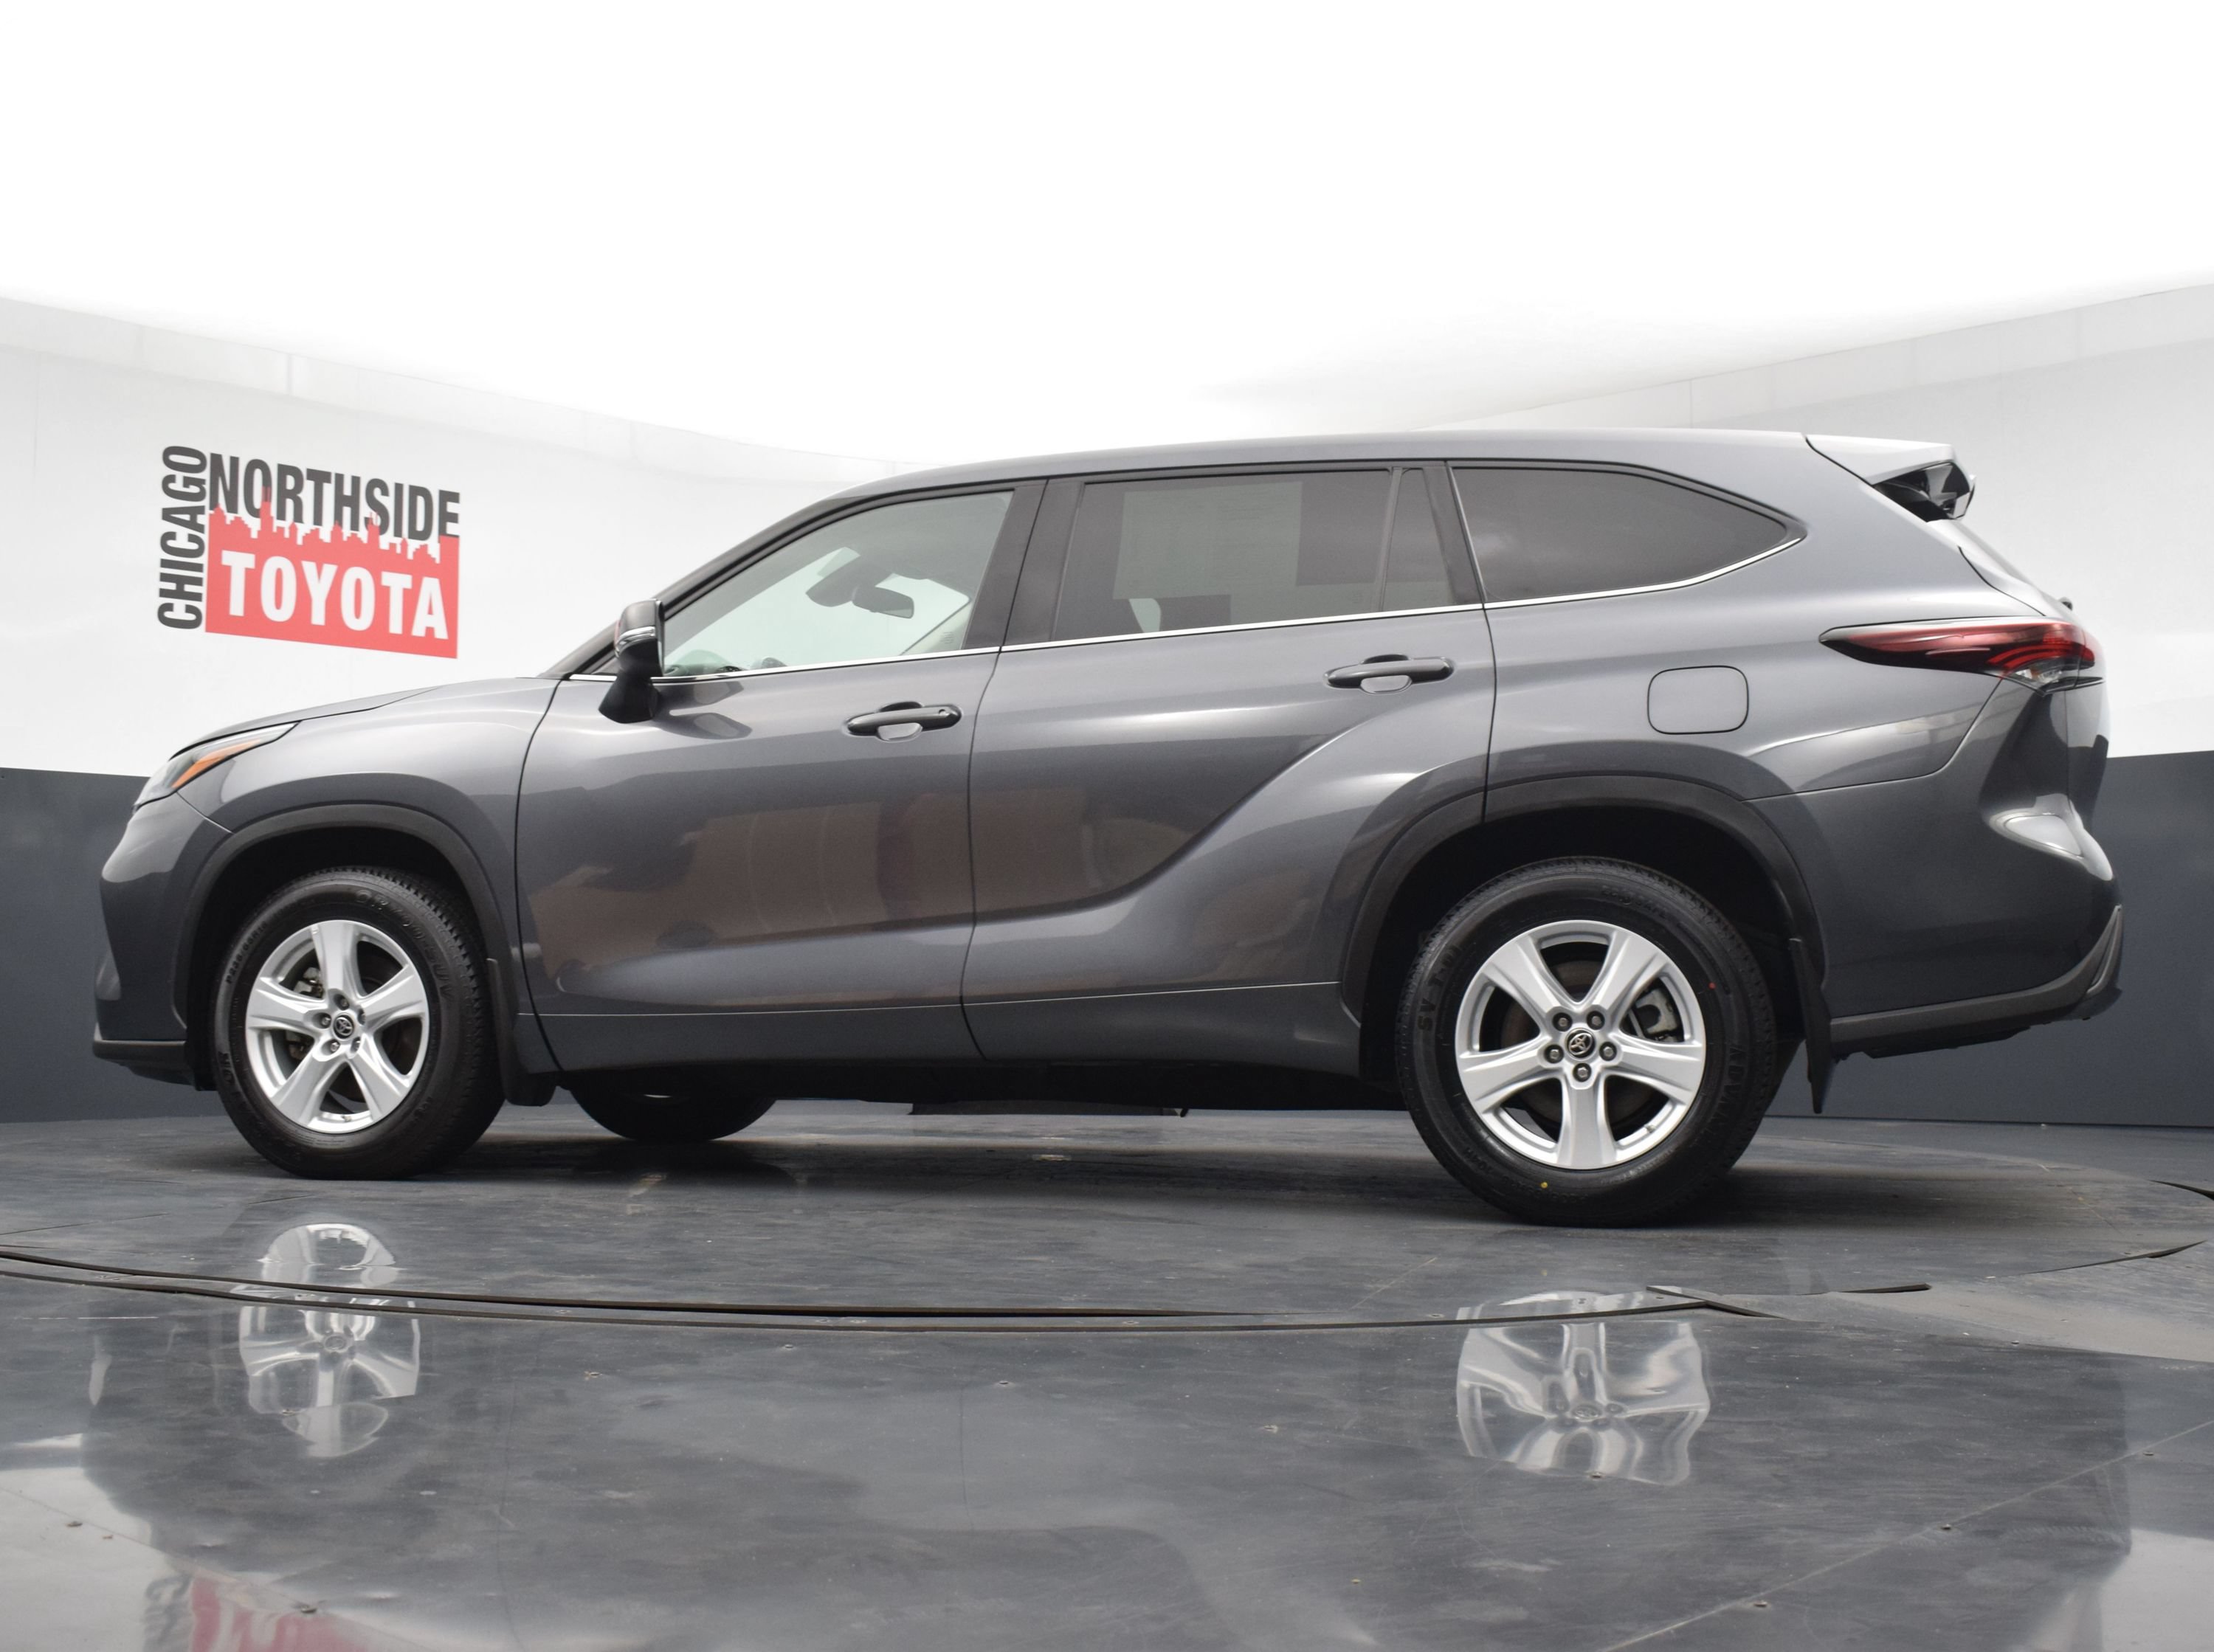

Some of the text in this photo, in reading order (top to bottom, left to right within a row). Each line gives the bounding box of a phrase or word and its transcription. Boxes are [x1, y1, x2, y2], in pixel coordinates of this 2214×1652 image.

[157, 446, 207, 629] CHICAGO
[209, 452, 461, 542] NORTHSIDE
[221, 550, 449, 640] TOYOTA
